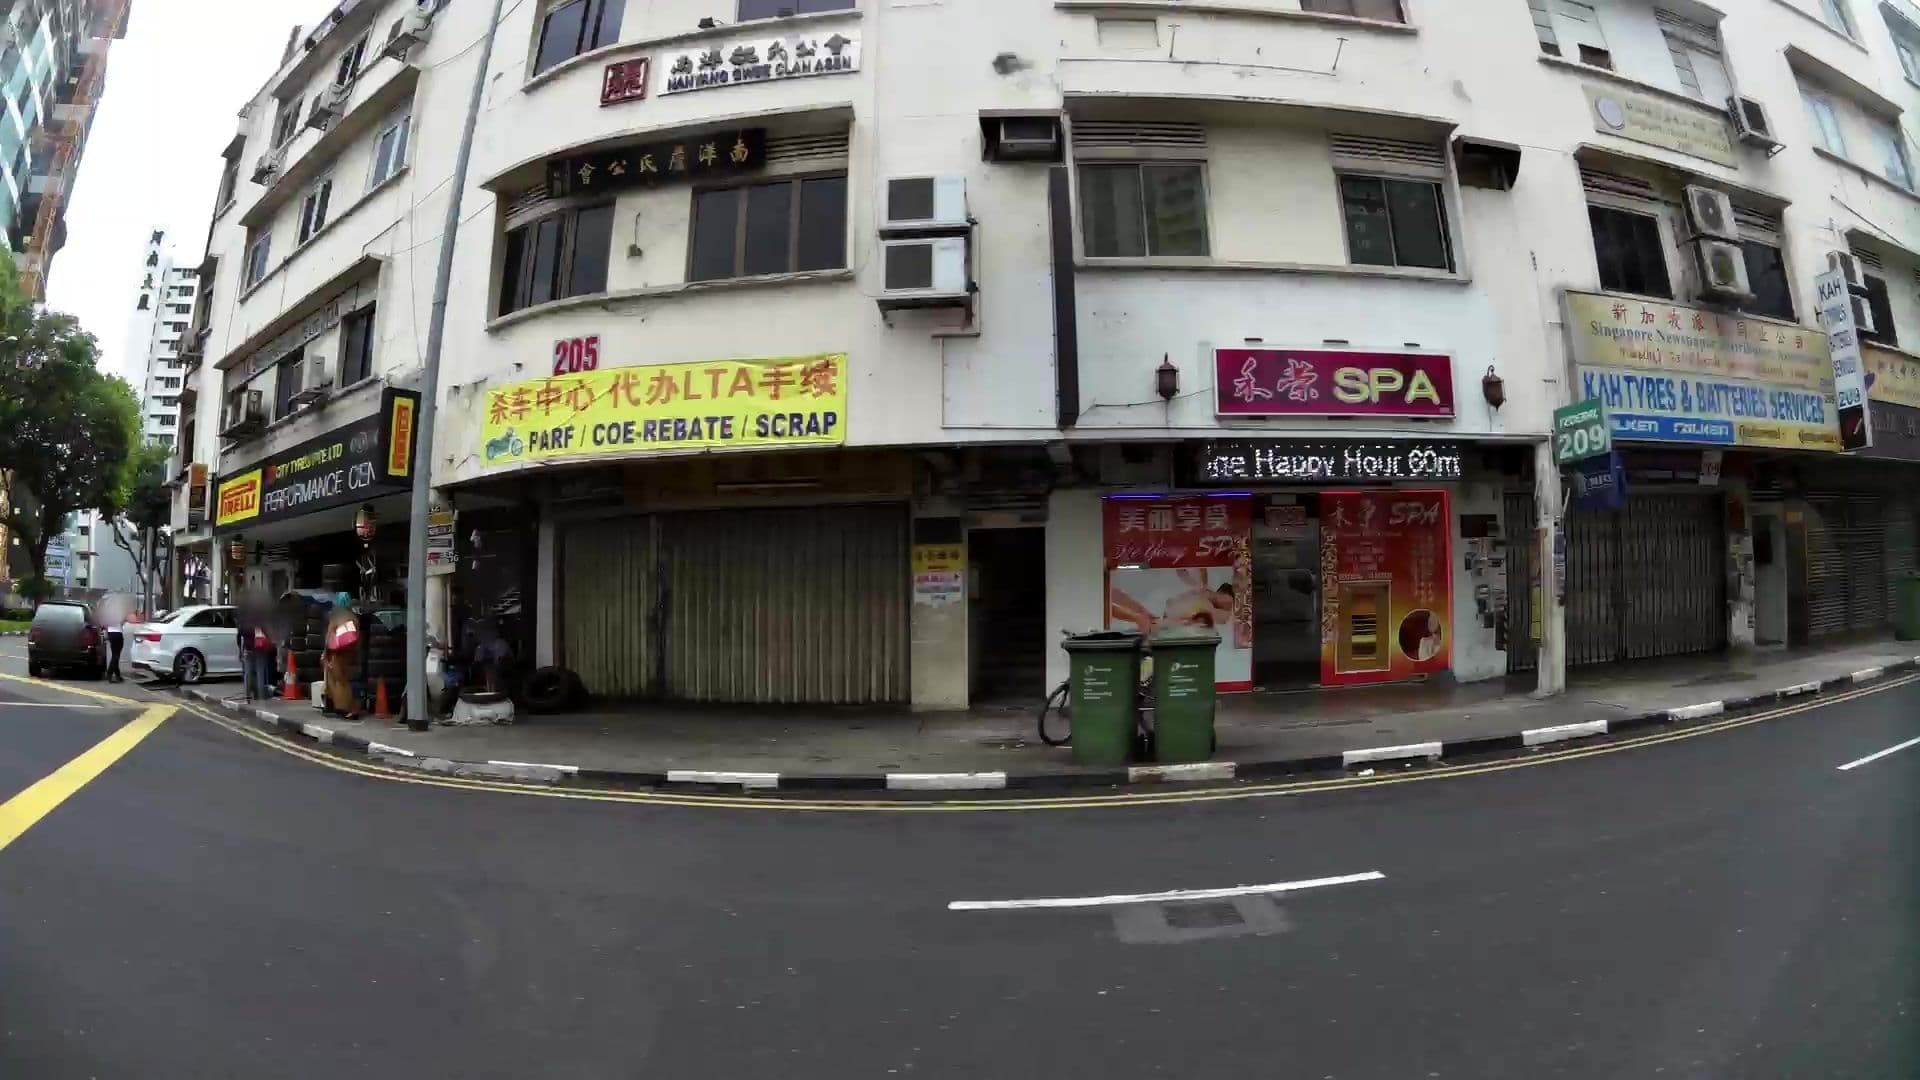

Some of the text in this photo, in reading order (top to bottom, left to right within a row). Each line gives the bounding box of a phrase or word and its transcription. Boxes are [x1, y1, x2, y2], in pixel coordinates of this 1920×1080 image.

[1818, 278, 1843, 301] KAH
[554, 335, 600, 377] 205
[1334, 366, 1441, 406] SPA
[1583, 370, 1623, 408] KAH
[1624, 375, 1677, 411] TYRES
[1680, 379, 1693, 413] &
[1695, 381, 1768, 418] BATTERIES
[1769, 390, 1826, 425] SERVICES
[529, 423, 575, 453] PARF
[592, 414, 735, 447] COE-REBATE
[755, 411, 838, 438] SCRAP
[1558, 423, 1606, 461] 209
[1612, 417, 1659, 433] LKEN
[1255, 448, 1336, 477] Happy
[1344, 448, 1403, 474] Hour
[220, 479, 257, 518] PIRELLI
[264, 468, 344, 513] PERFORMANCE
[1388, 501, 1441, 527] SPA
[1196, 534, 1238, 559] SP
